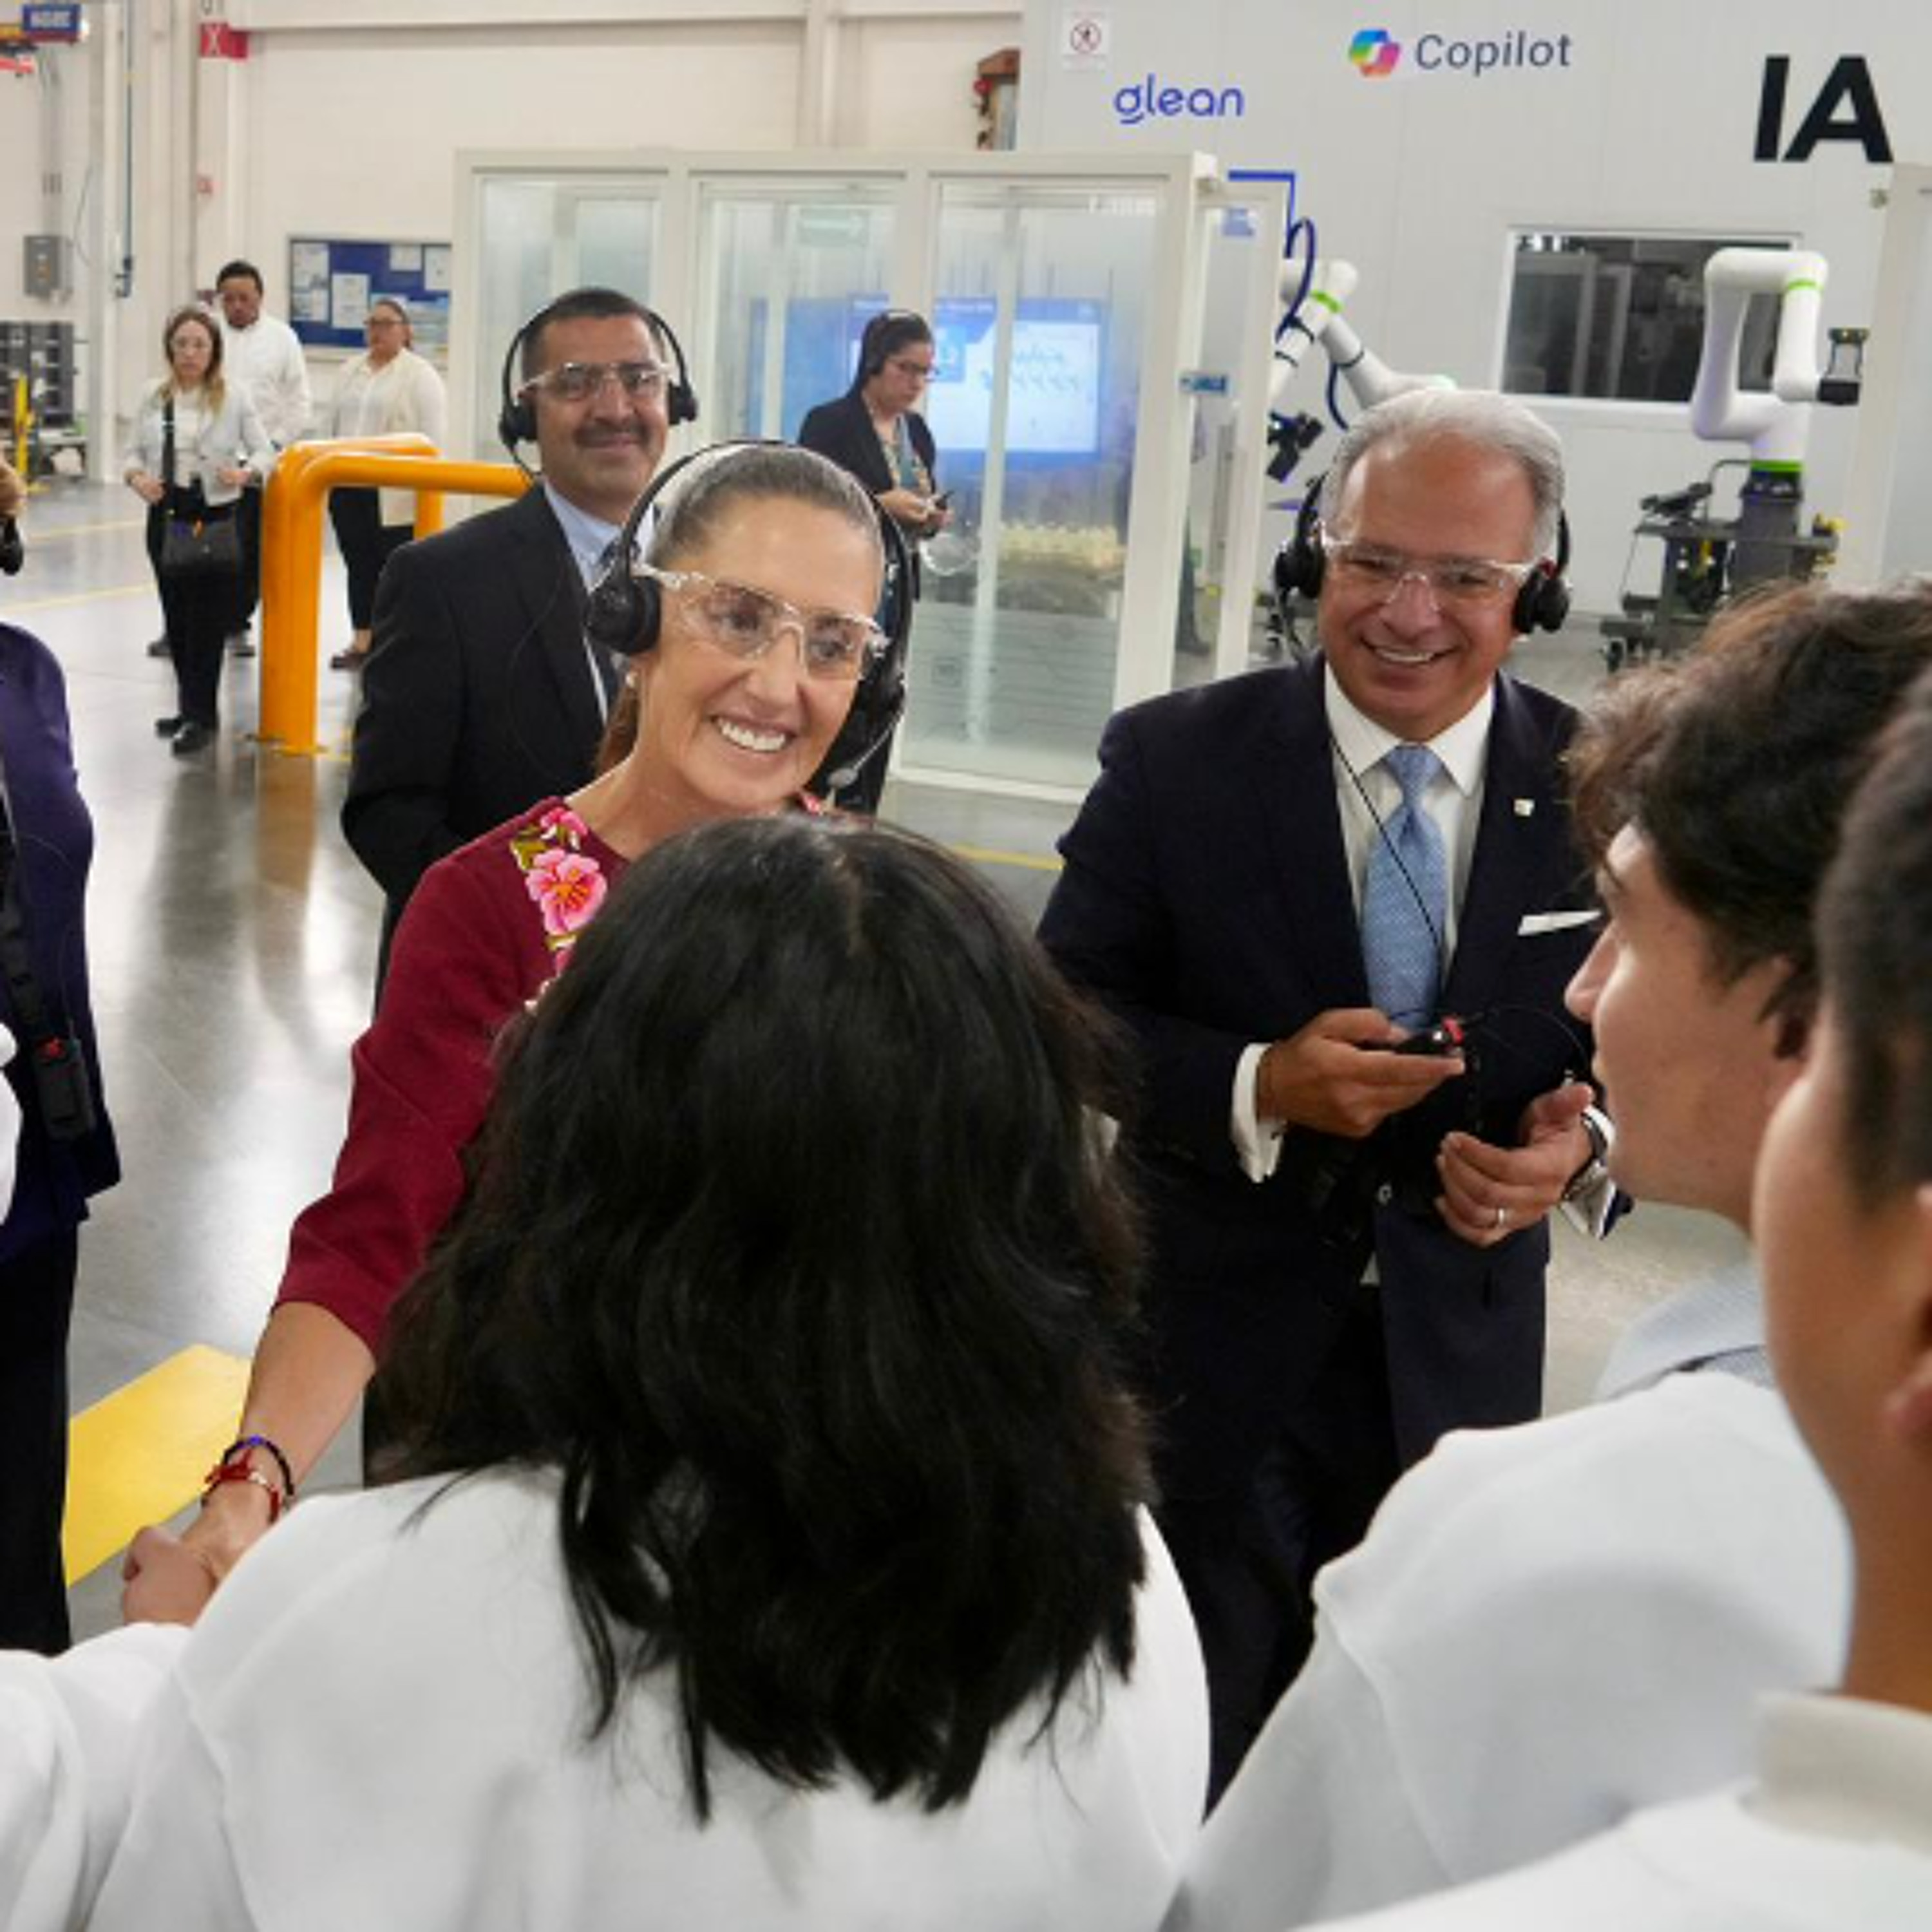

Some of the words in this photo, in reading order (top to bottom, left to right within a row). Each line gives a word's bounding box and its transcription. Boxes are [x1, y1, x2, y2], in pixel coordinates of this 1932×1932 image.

[1416, 30, 1572, 77] Copilot
[1115, 73, 1244, 124] glean
[1754, 55, 1894, 162] IA
